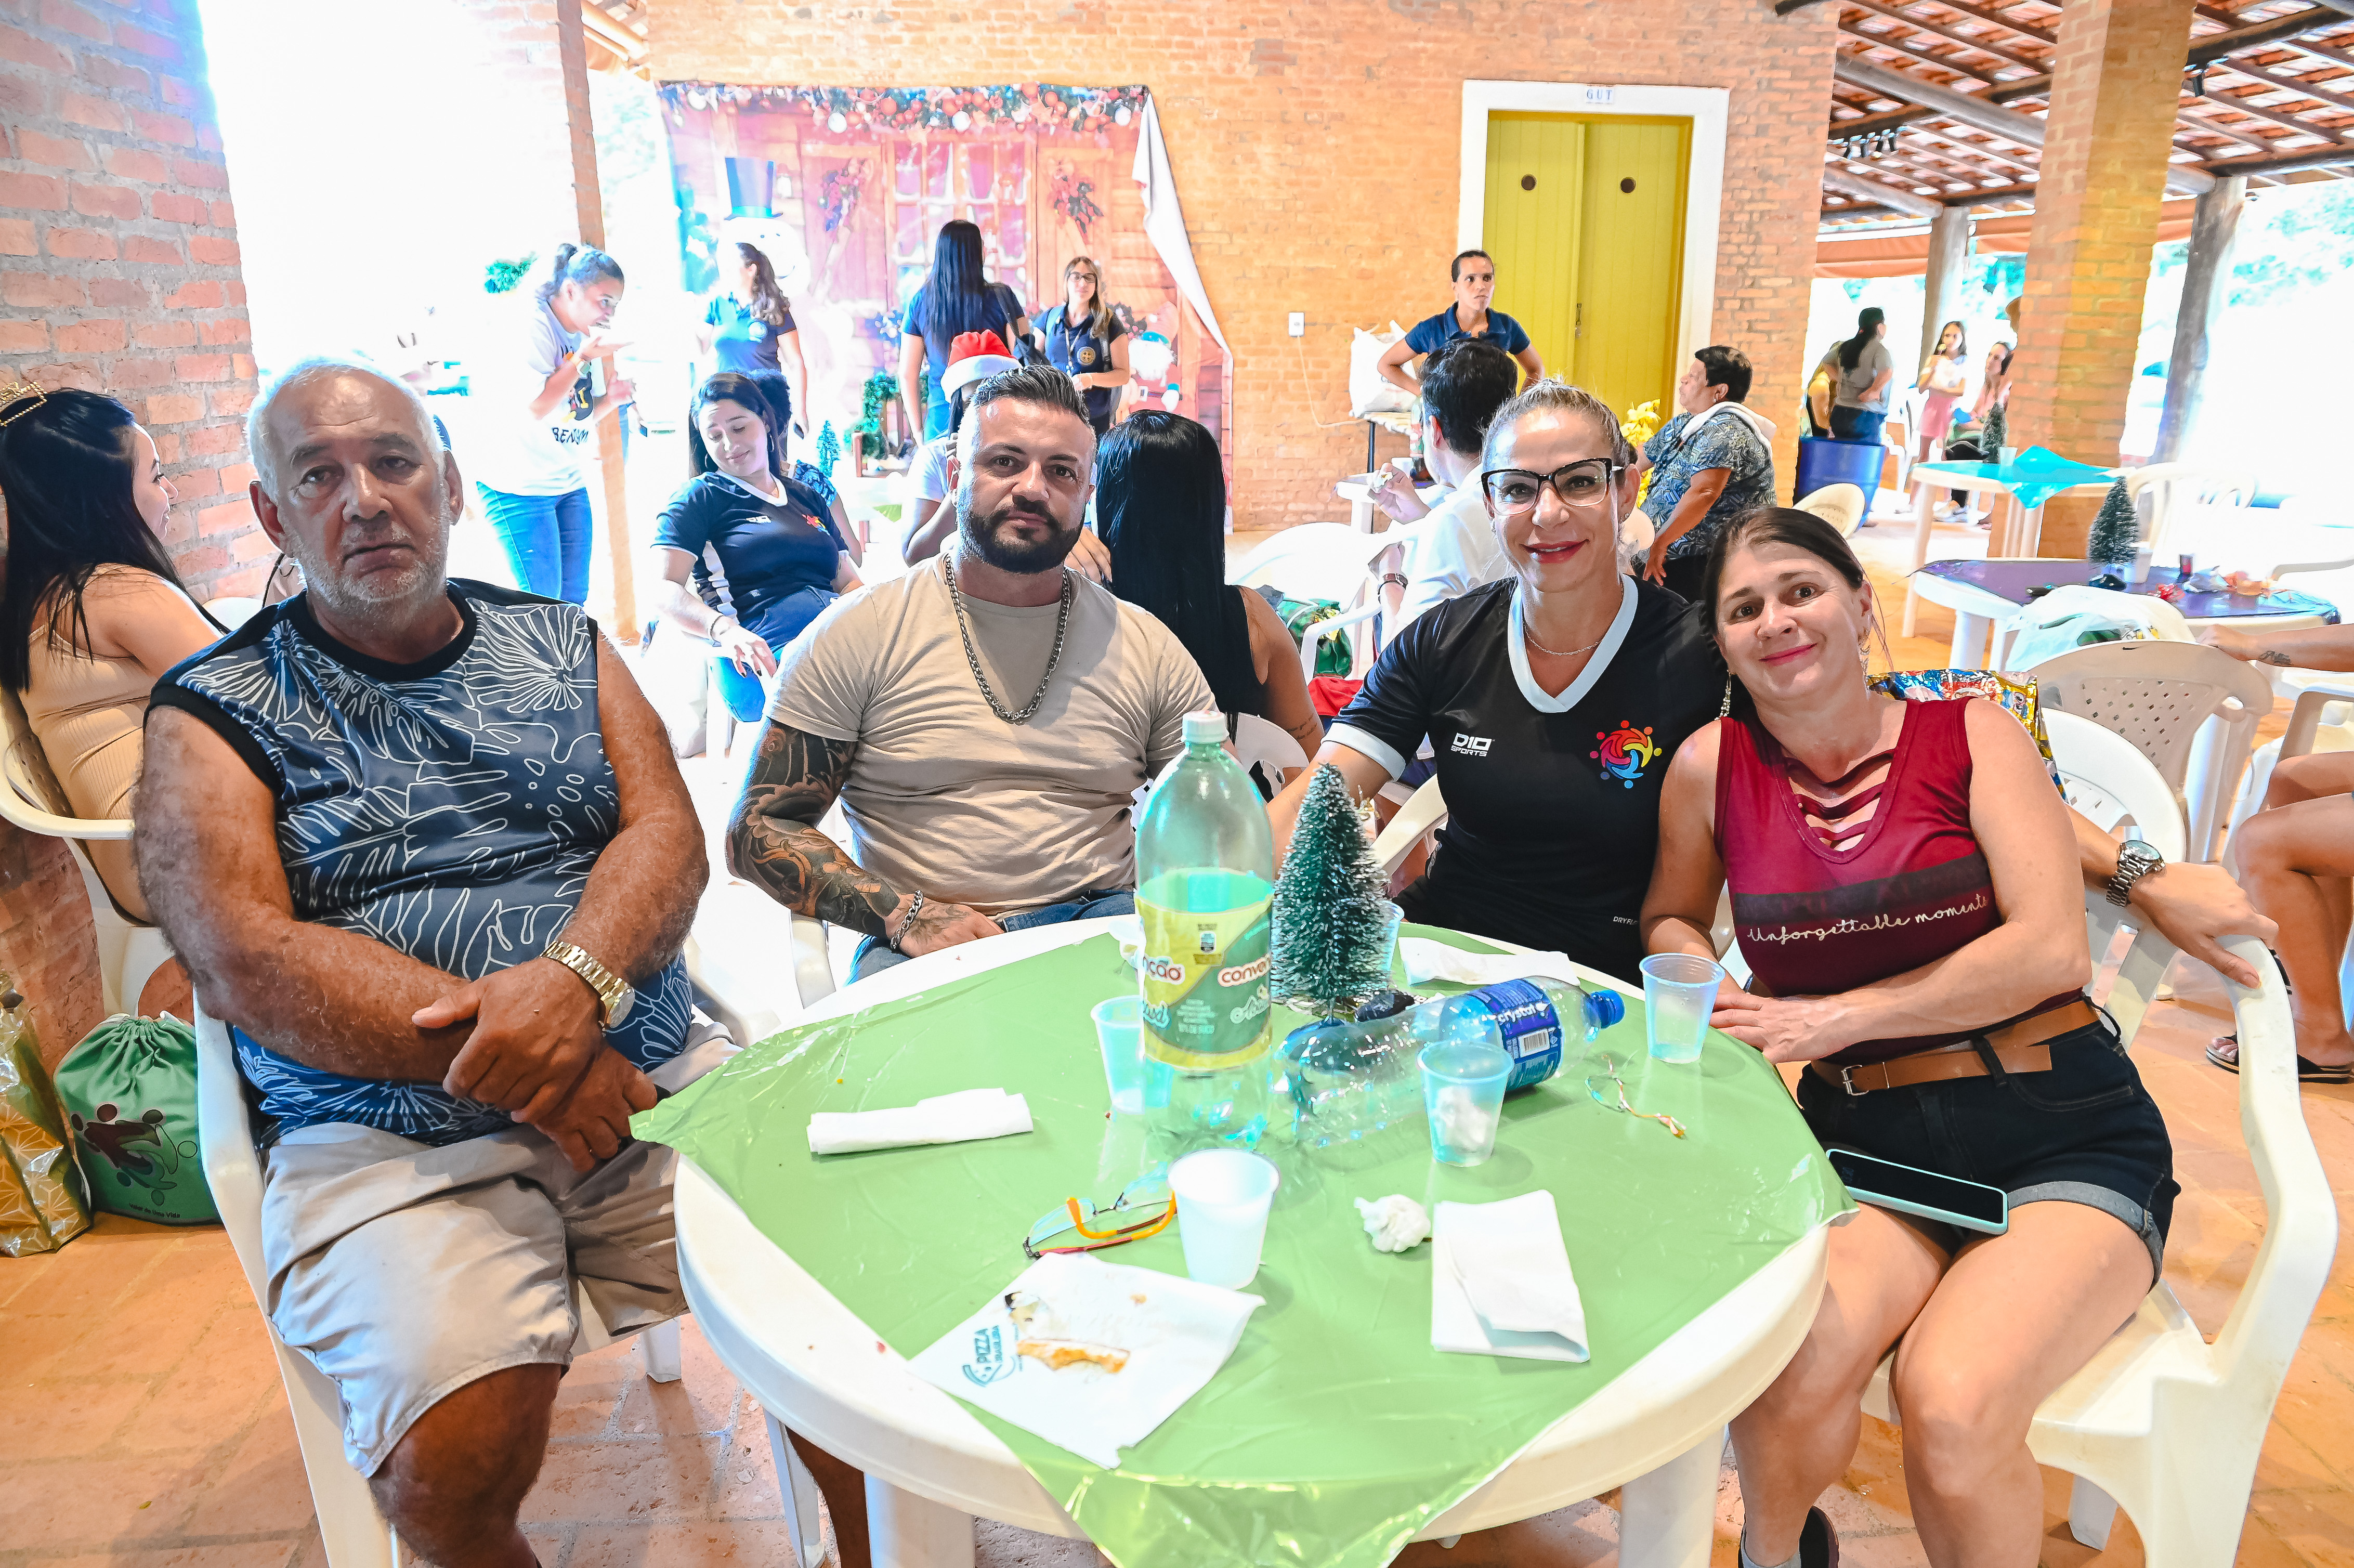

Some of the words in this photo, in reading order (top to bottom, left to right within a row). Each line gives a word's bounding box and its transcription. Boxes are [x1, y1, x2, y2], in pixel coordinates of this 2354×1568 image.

[1450, 745, 1487, 757] SPORTS
[1747, 913, 1911, 945] Unforgettable
[1915, 893, 1988, 923] moments
[974, 1328, 991, 1363] PIZZA
